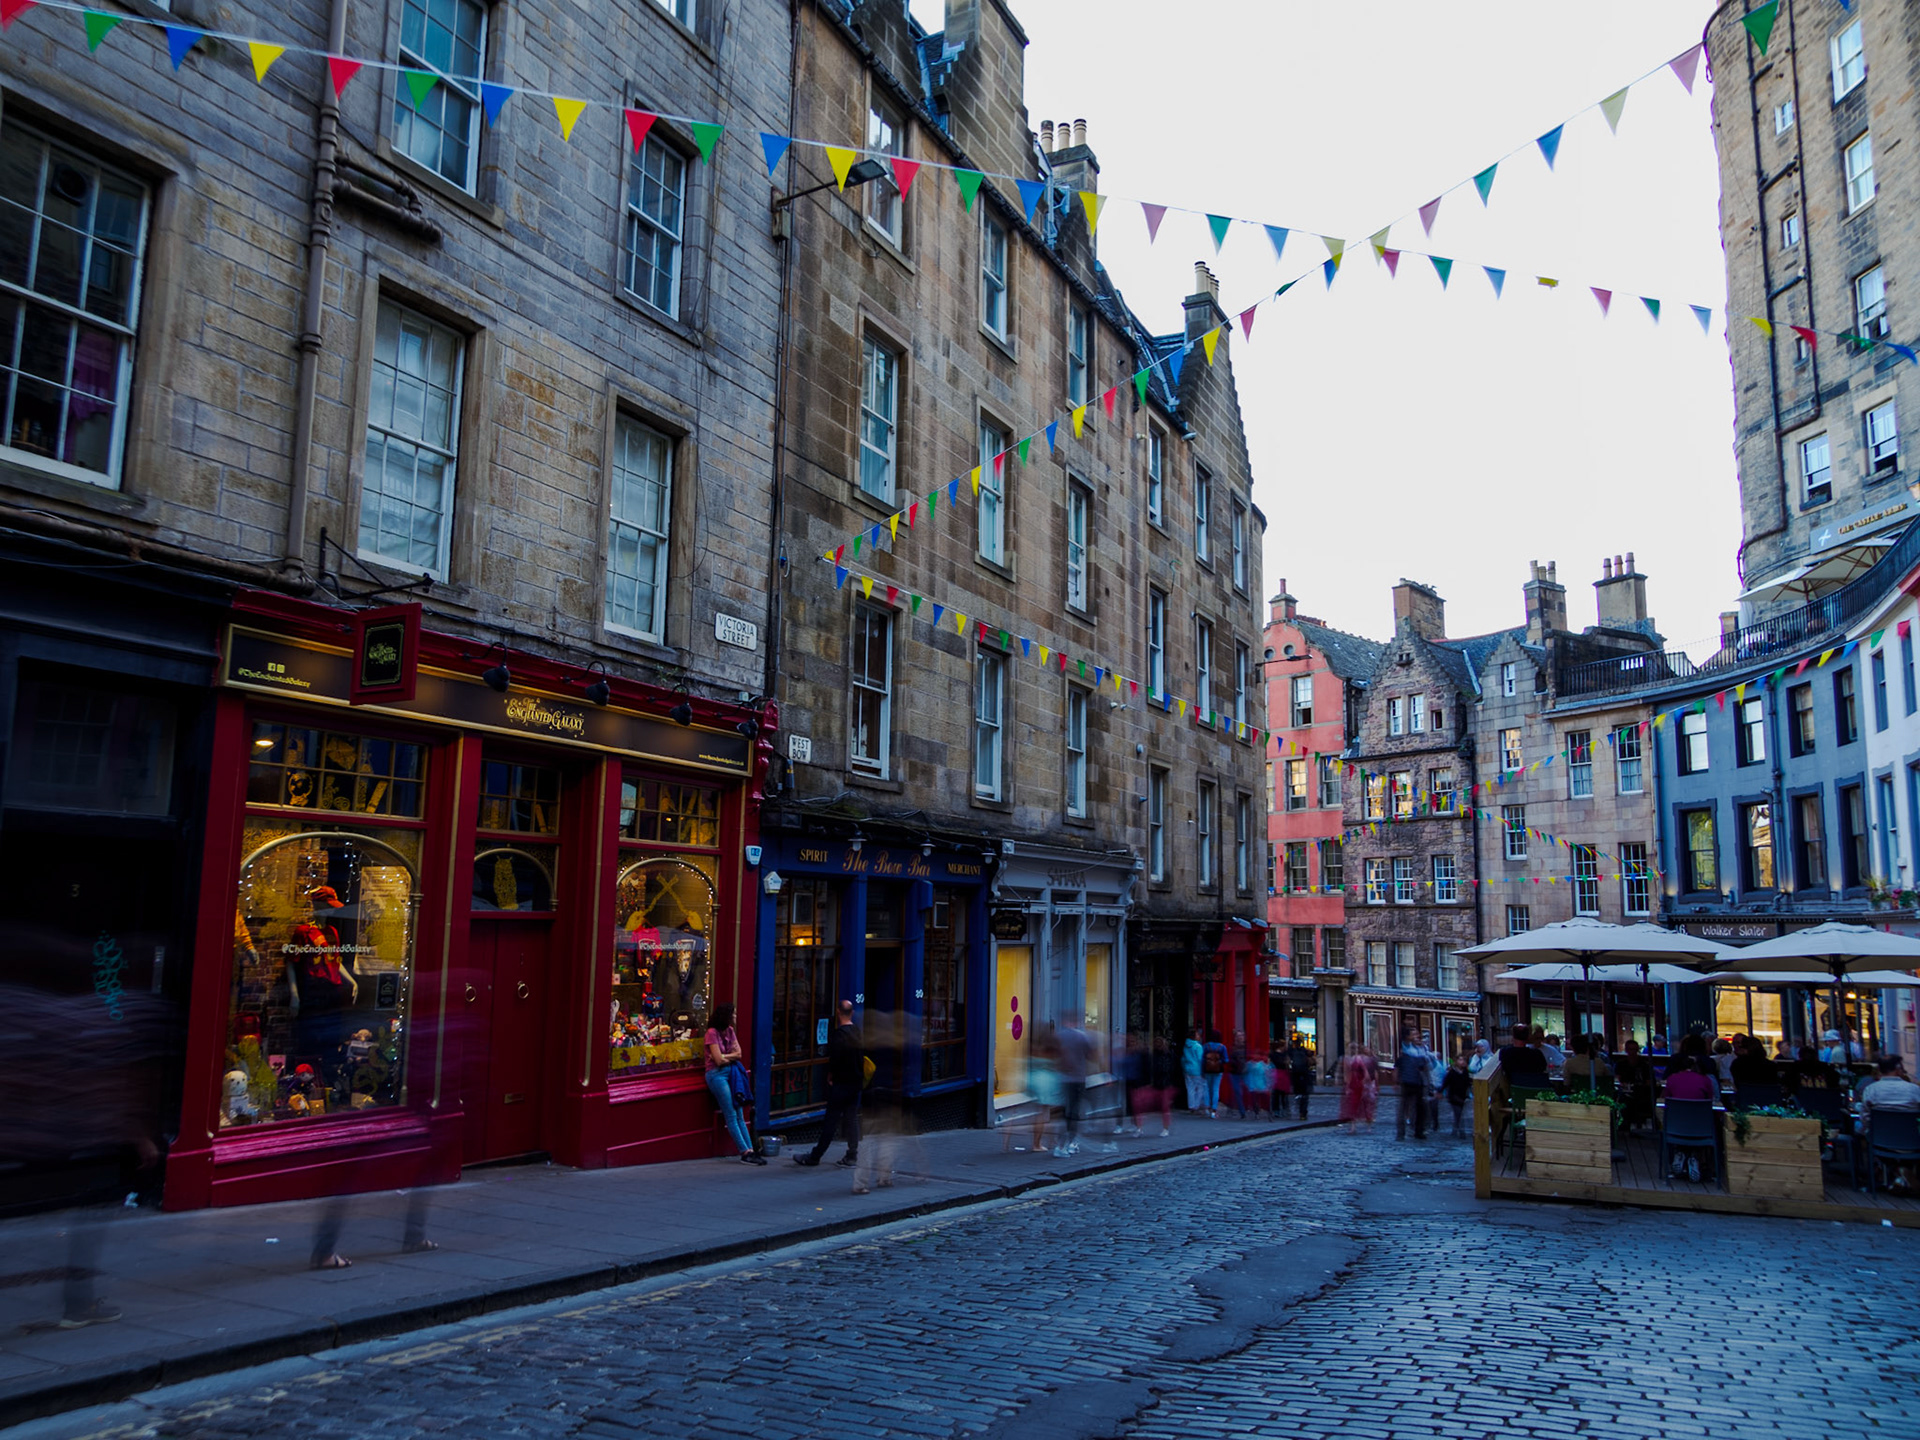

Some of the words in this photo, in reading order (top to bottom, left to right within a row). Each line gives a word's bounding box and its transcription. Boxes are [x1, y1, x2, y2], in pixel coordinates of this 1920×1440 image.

[718, 615, 754, 637] VICTORIA
[723, 629, 750, 646] STREET
[792, 737, 809, 750] WEST
[793, 748, 808, 760] BOW
[800, 848, 828, 863] SPIRIT
[843, 847, 868, 872] The
[875, 850, 903, 874] Bow
[907, 853, 931, 877] Bar
[947, 863, 981, 876] MERCHANT
[71, 884, 81, 898] 3
[1702, 924, 1733, 936] Walker
[1739, 924, 1766, 937] Slater
